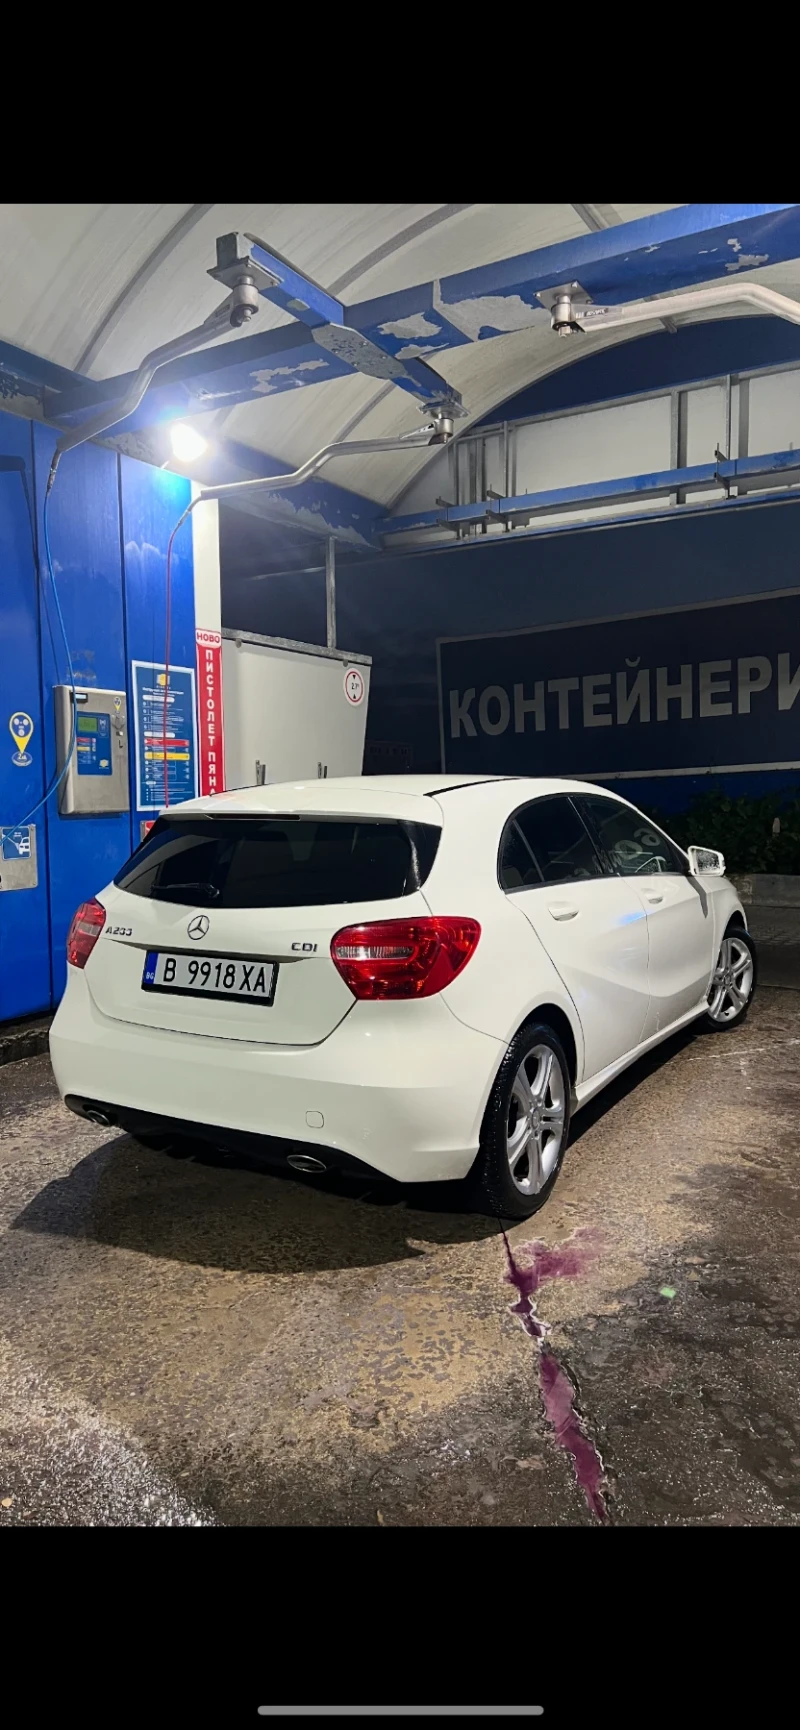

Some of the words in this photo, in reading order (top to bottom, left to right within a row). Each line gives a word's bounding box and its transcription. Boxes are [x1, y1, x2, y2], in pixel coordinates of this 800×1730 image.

[196, 632, 220, 643] НОВО
[205, 649, 216, 747] ПИСТОЛЕТ
[291, 942, 318, 953] CDI
[145, 971, 154, 980] BG
[163, 957, 176, 983] B
[188, 959, 236, 989] 9918
[239, 963, 267, 994] XA
